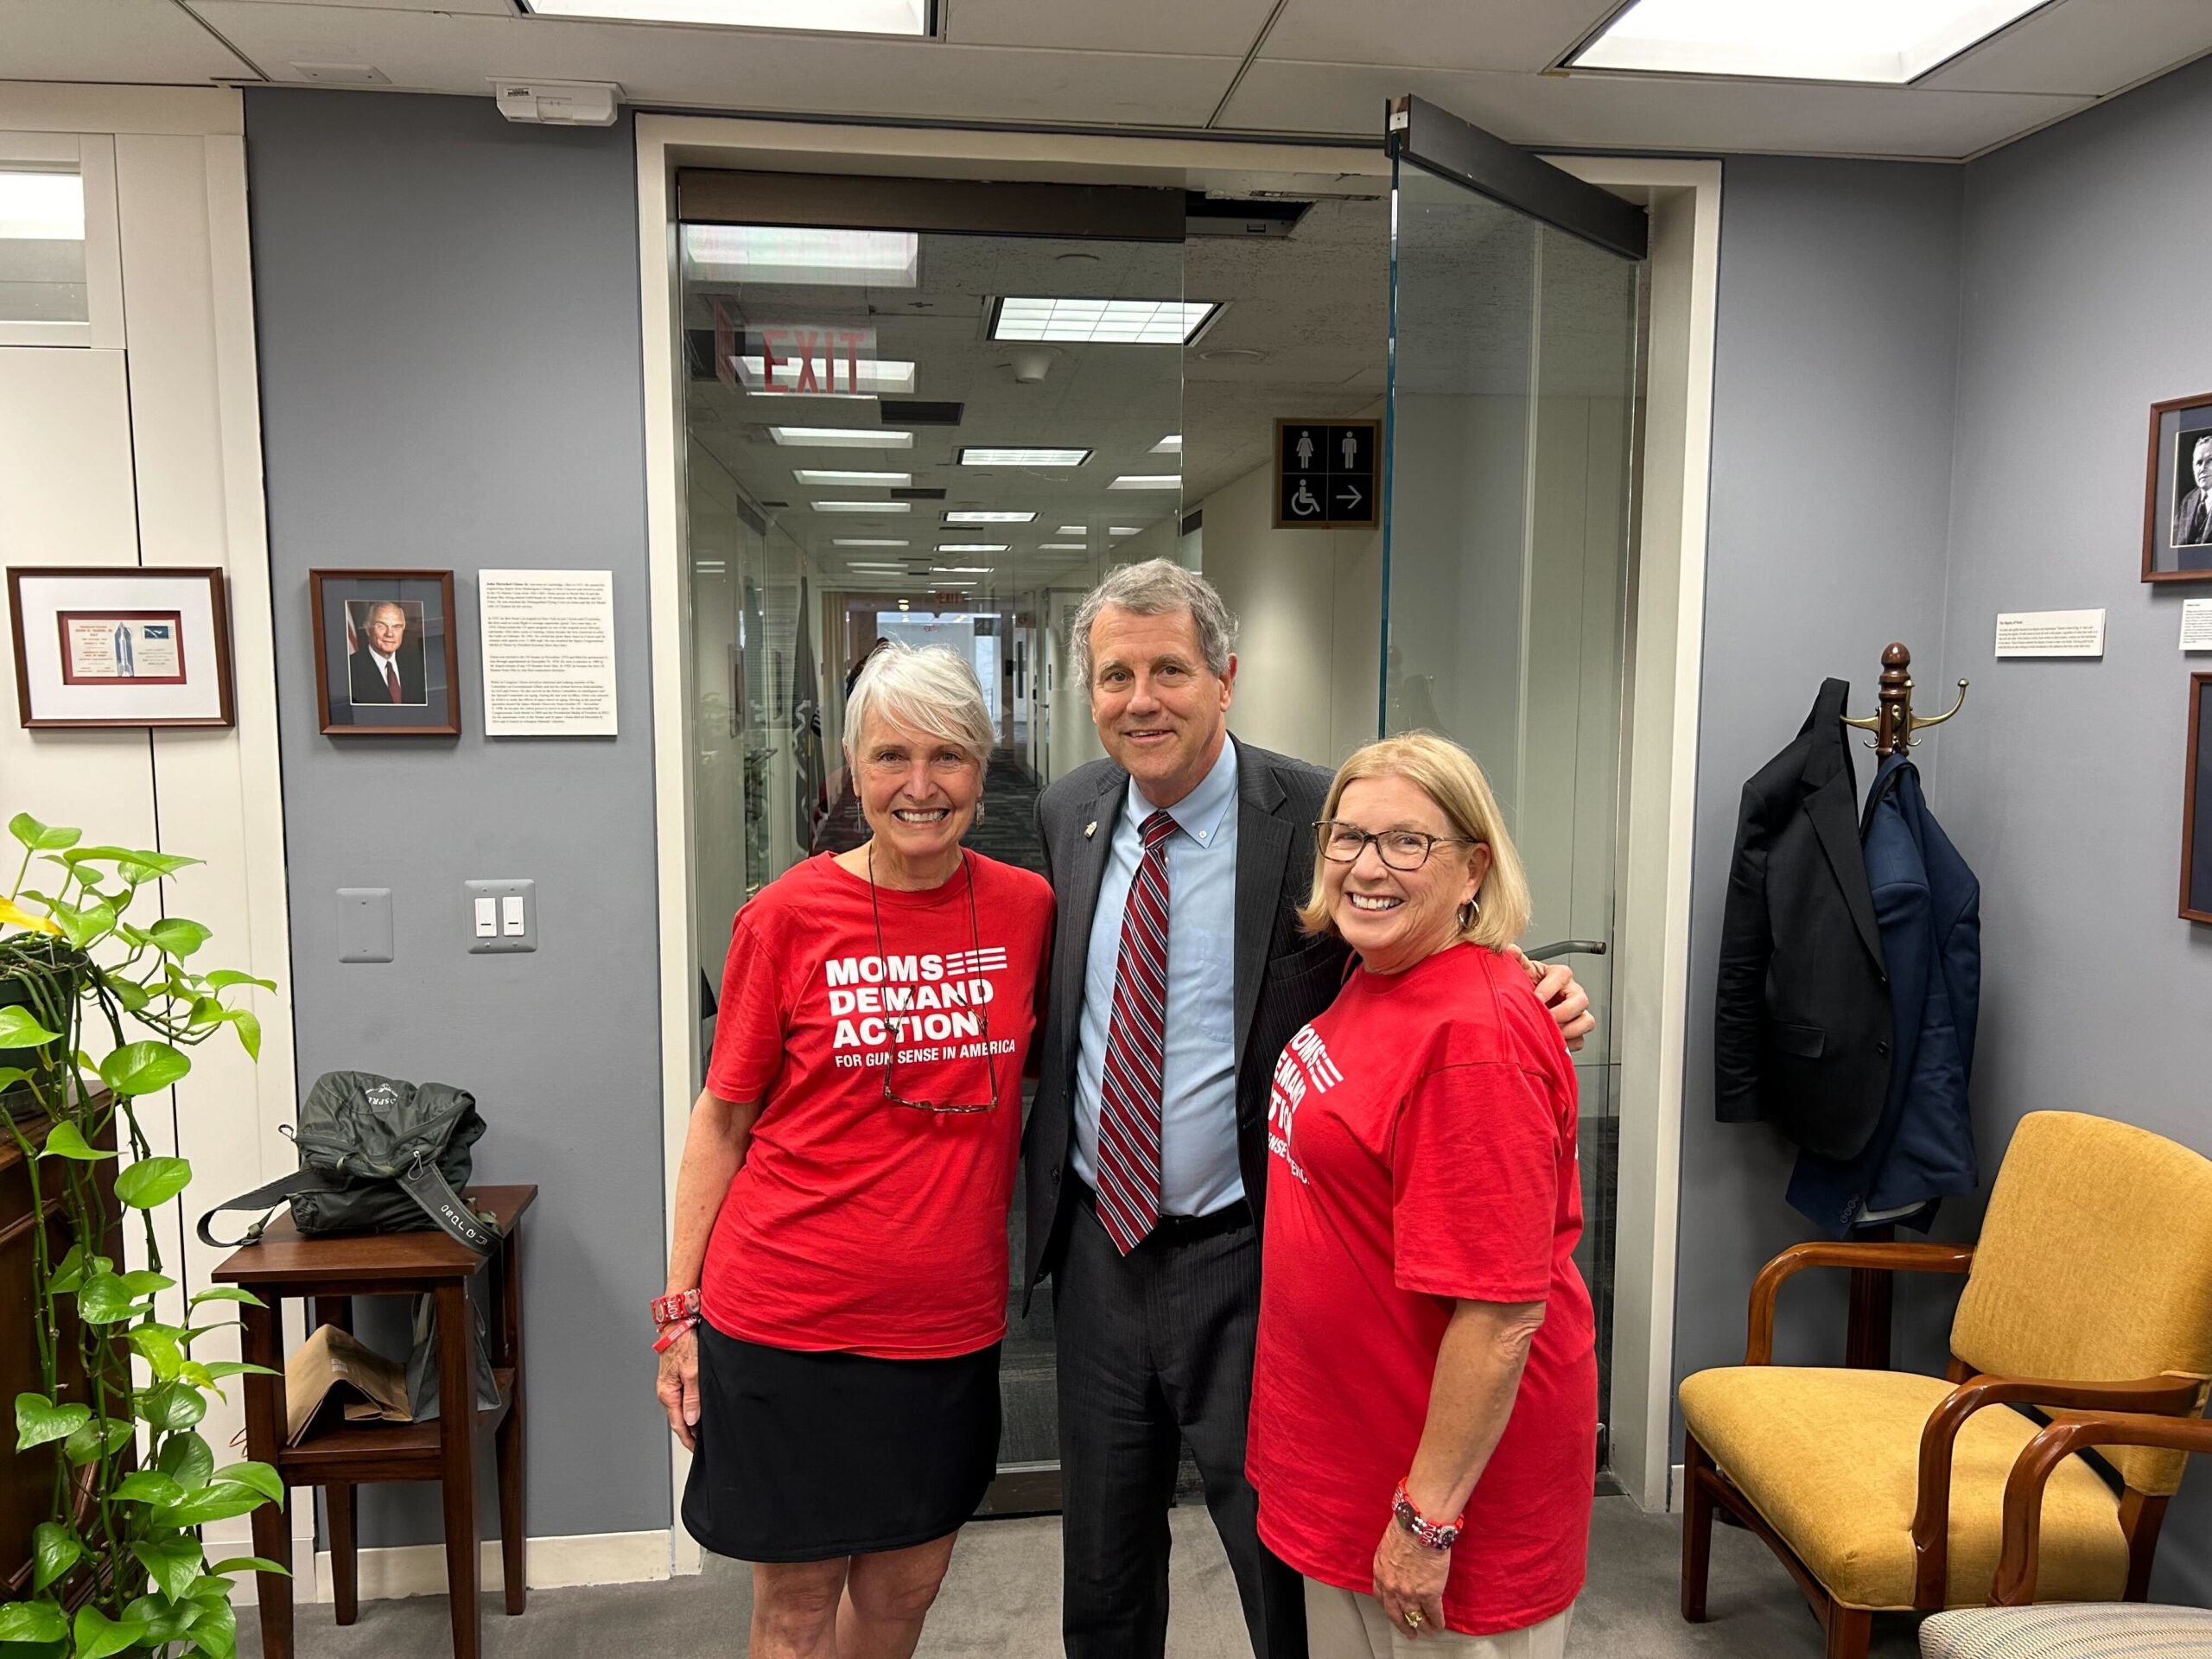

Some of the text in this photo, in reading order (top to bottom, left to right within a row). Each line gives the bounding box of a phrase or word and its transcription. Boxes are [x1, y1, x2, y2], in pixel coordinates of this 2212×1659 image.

[763, 330, 864, 393] EXIT
[825, 954, 944, 987] MOMS
[829, 978, 995, 1016] DEMAND
[832, 1011, 983, 1049] ACTION
[835, 1039, 1015, 1068] FOR GUN SENSE IN AMERICA
[1274, 1049, 1307, 1115] EMAND
